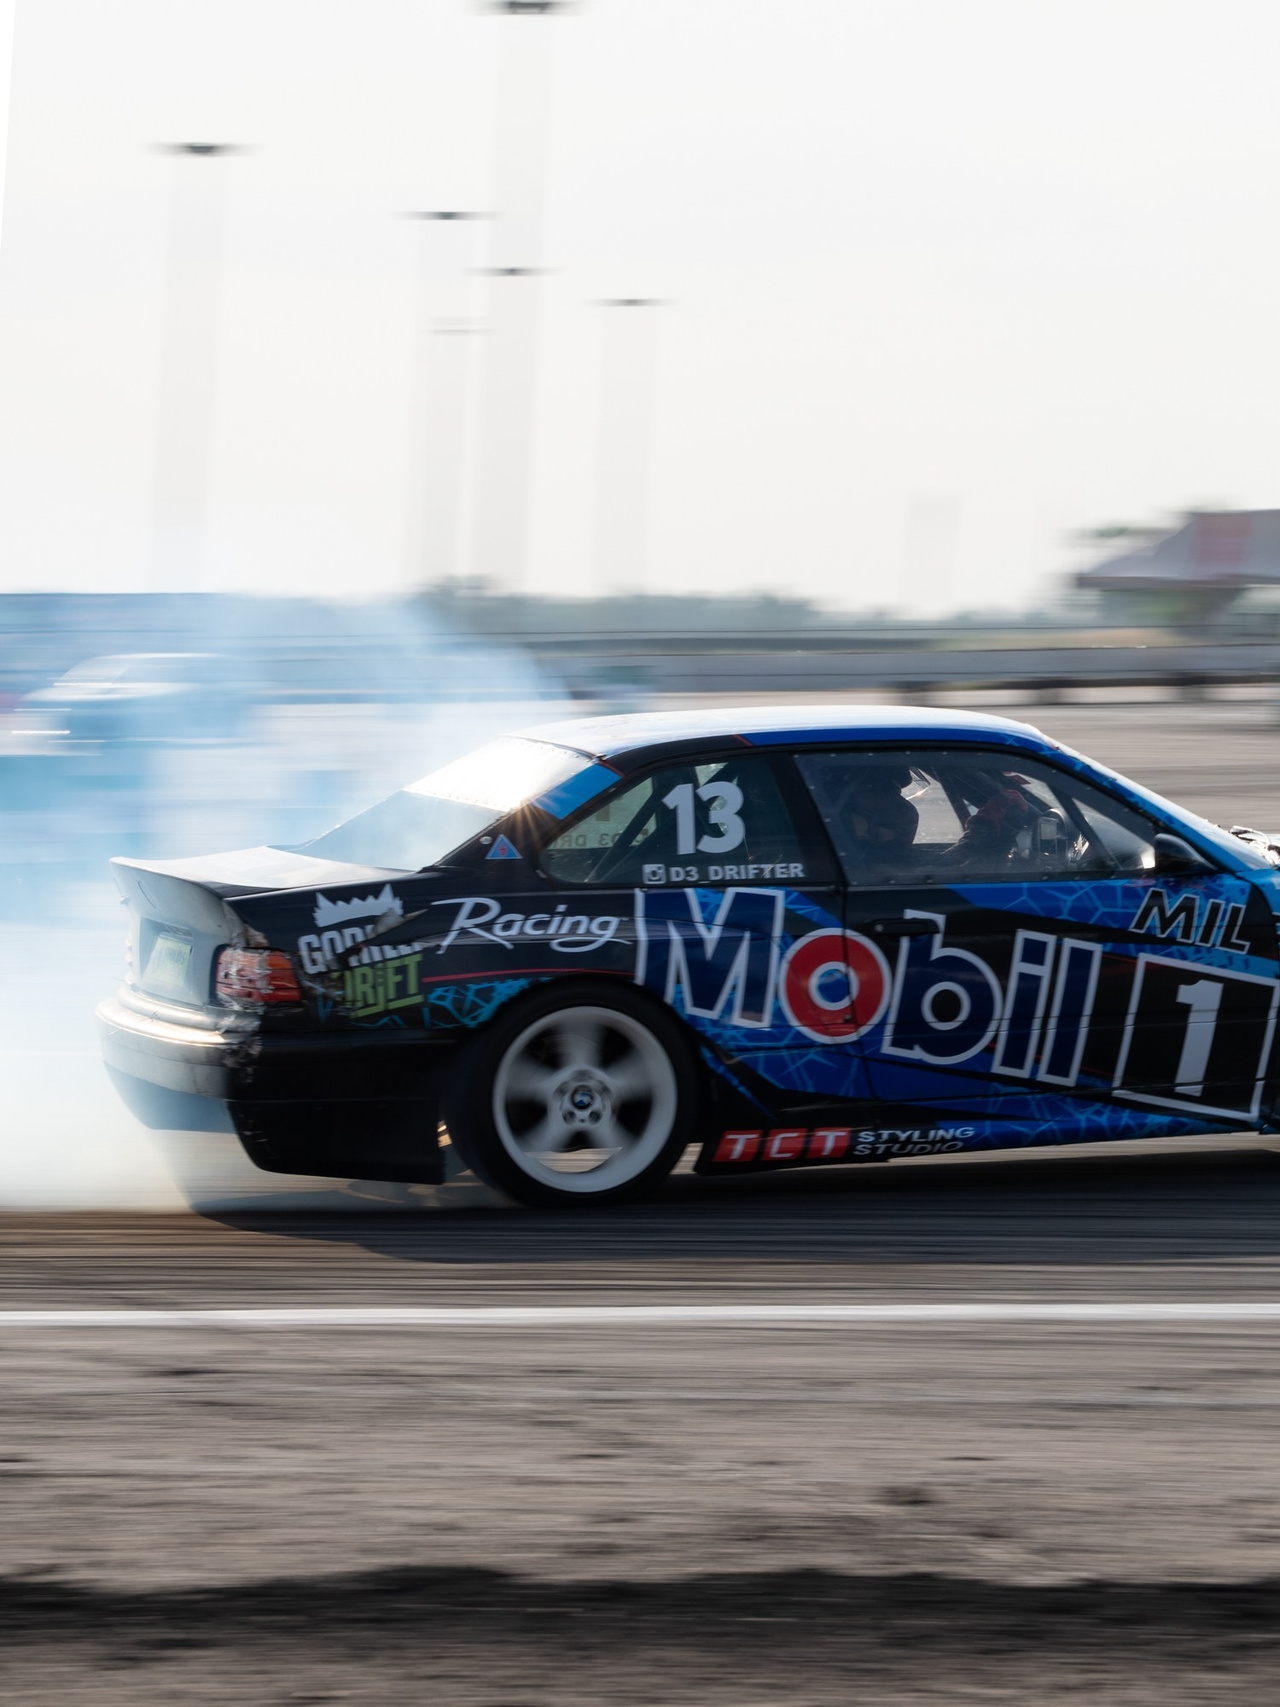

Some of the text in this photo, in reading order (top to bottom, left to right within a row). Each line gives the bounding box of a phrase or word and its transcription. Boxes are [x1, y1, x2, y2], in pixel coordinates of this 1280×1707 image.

[662, 781, 745, 855] 13
[669, 863, 805, 884] D3_DRIFTER
[431, 897, 633, 955] Racing
[634, 886, 1104, 1088] Mobil
[1175, 979, 1225, 1098] 1
[724, 1126, 975, 1160] TCT STYLING
[853, 1141, 964, 1156] STUDIO
